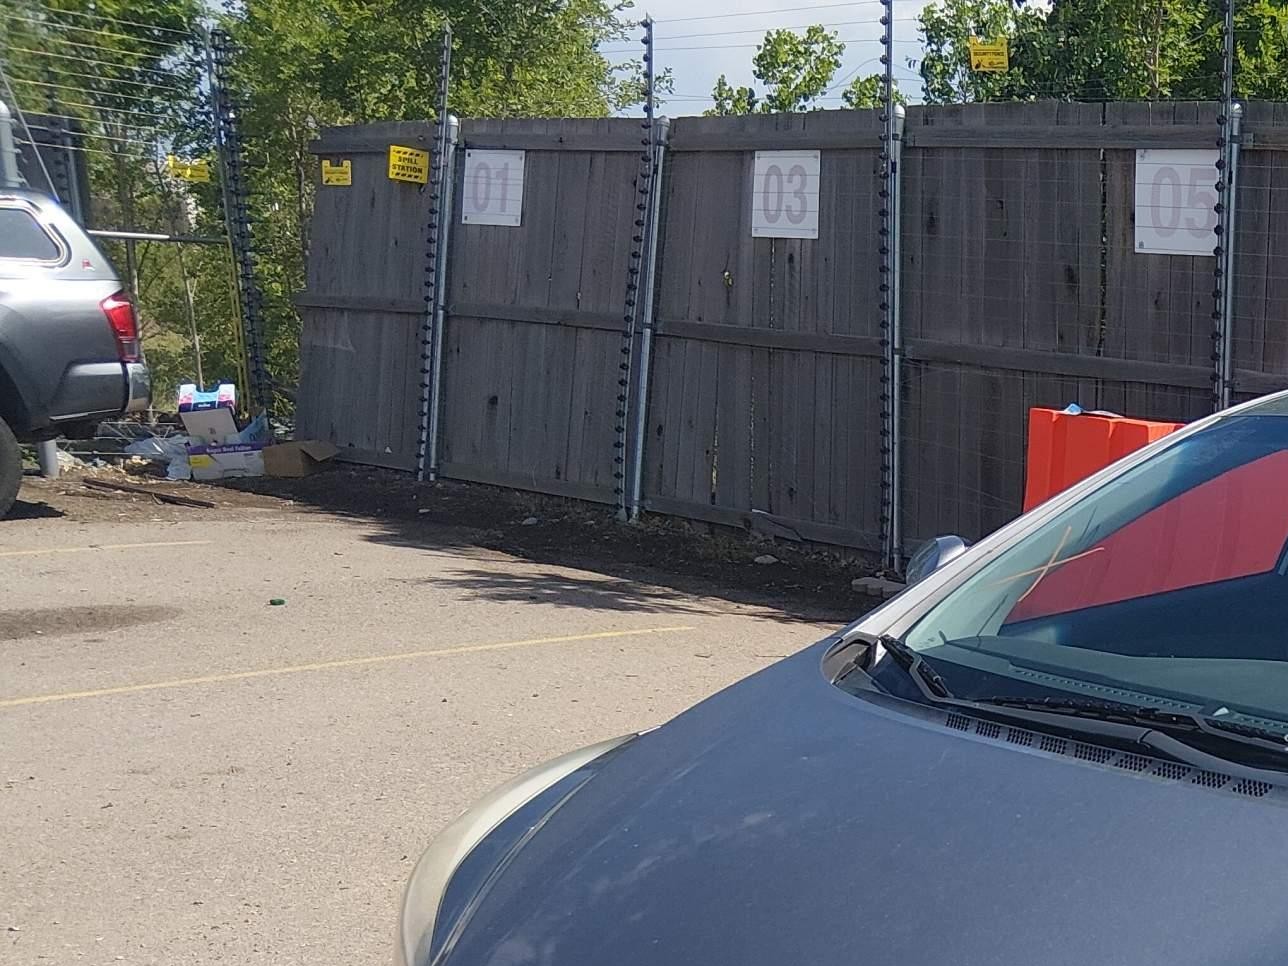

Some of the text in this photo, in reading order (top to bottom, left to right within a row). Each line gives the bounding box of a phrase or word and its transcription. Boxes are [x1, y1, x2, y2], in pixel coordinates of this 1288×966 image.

[392, 164, 423, 174] STATION
[398, 156, 418, 164] SPILL
[472, 162, 510, 213] 01
[763, 164, 808, 224] 03
[1151, 166, 1217, 239] 05
